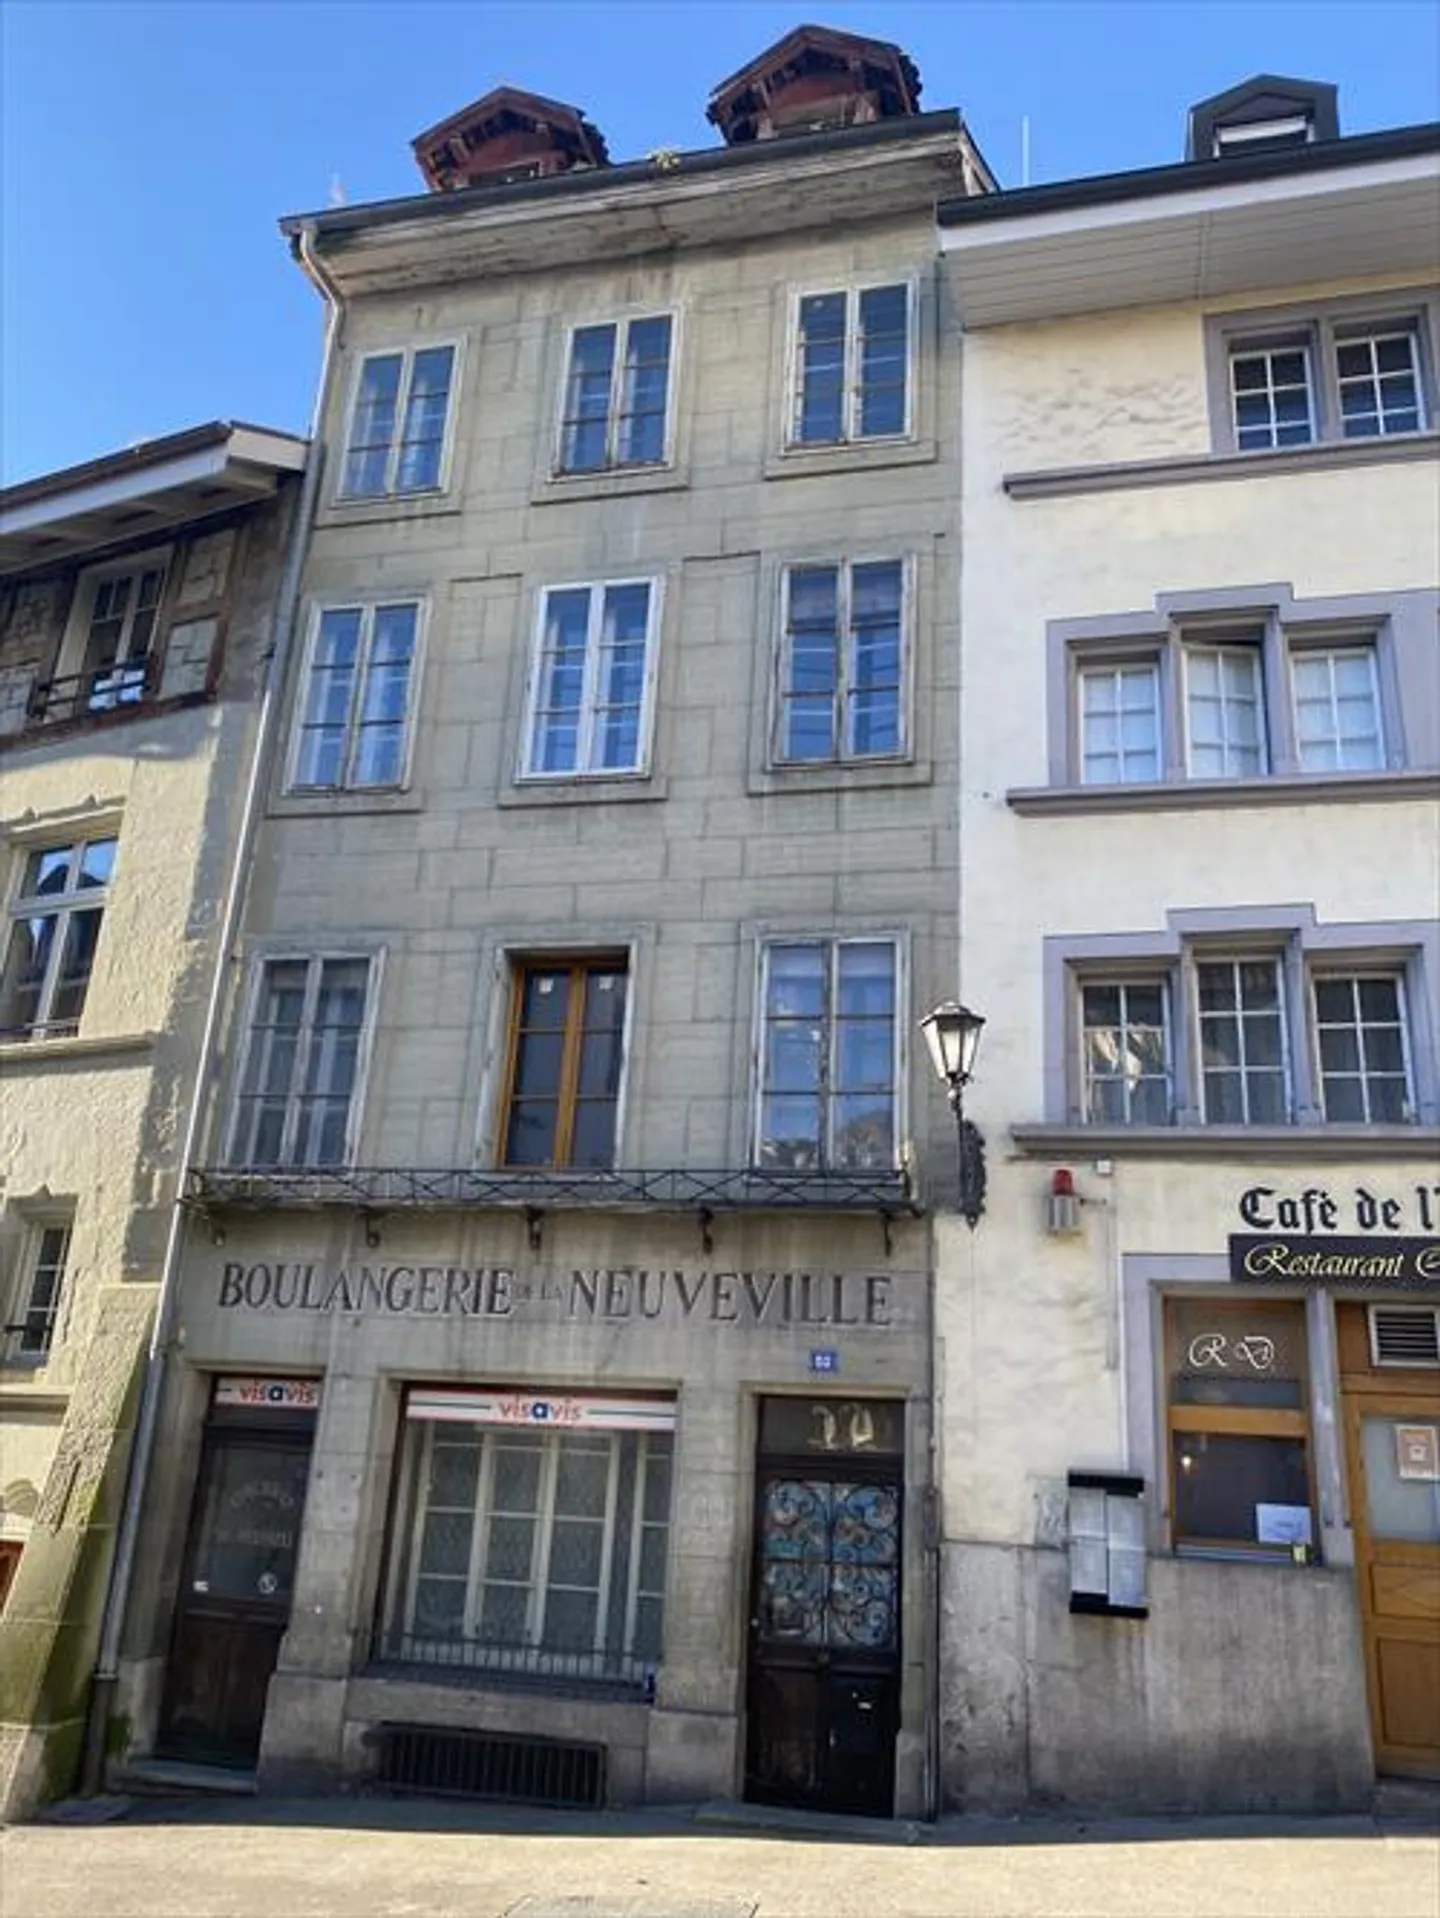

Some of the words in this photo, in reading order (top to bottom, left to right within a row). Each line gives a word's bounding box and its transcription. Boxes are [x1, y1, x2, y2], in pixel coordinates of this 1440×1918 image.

[1355, 1187, 1400, 1230] de
[1244, 1243, 1404, 1278] Restaurant
[218, 1262, 515, 1315] BOULANGERIE
[569, 1269, 892, 1326] NEUVEVILLE
[240, 1379, 316, 1404] visavis
[499, 1394, 582, 1421] visavis
